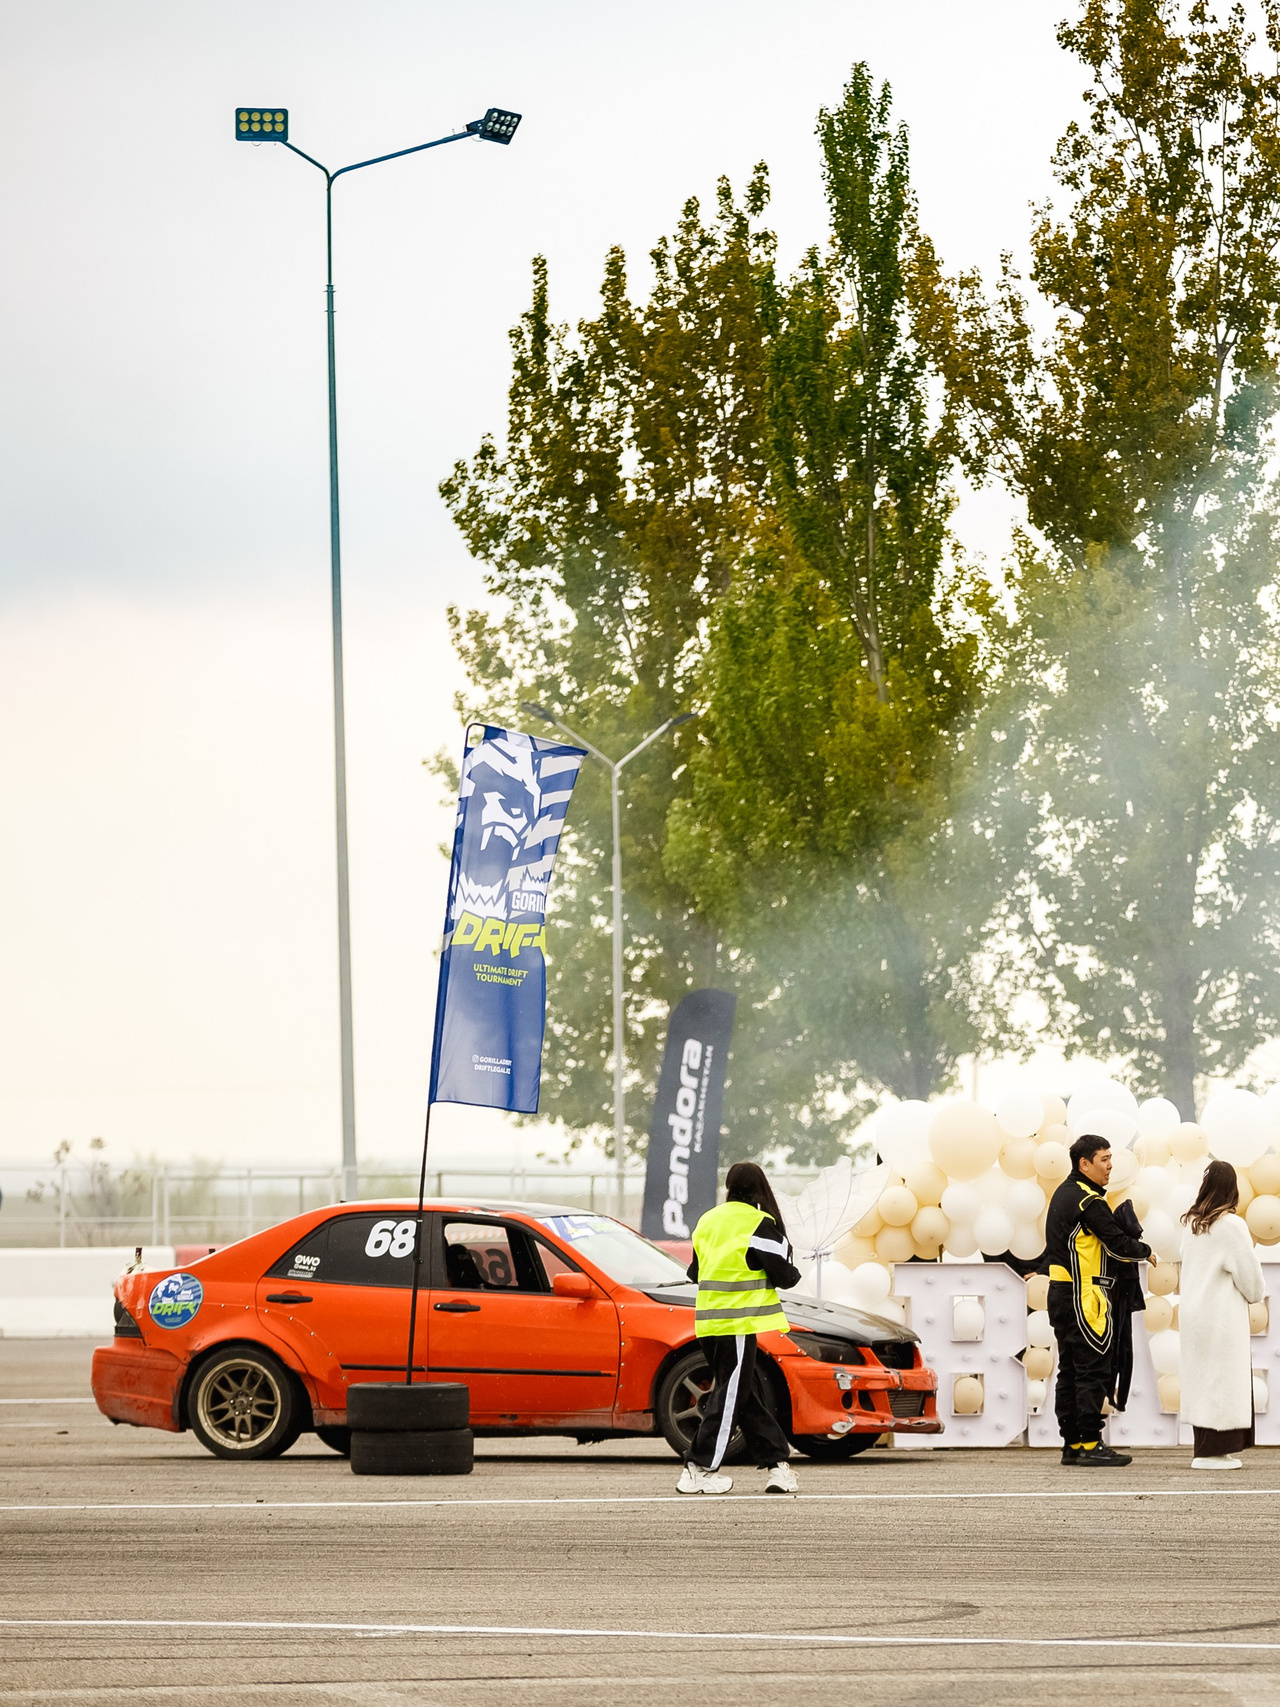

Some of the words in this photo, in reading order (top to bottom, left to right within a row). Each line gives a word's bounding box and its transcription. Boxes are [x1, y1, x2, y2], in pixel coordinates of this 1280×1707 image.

[473, 963, 508, 975] ULTIMATE
[508, 967, 528, 978] DRIFT
[476, 973, 523, 987] TOURNAMENT
[693, 1045, 714, 1154] KAZAKHSTAN
[365, 1219, 418, 1259] 68
[152, 1302, 196, 1316] DRIFT
